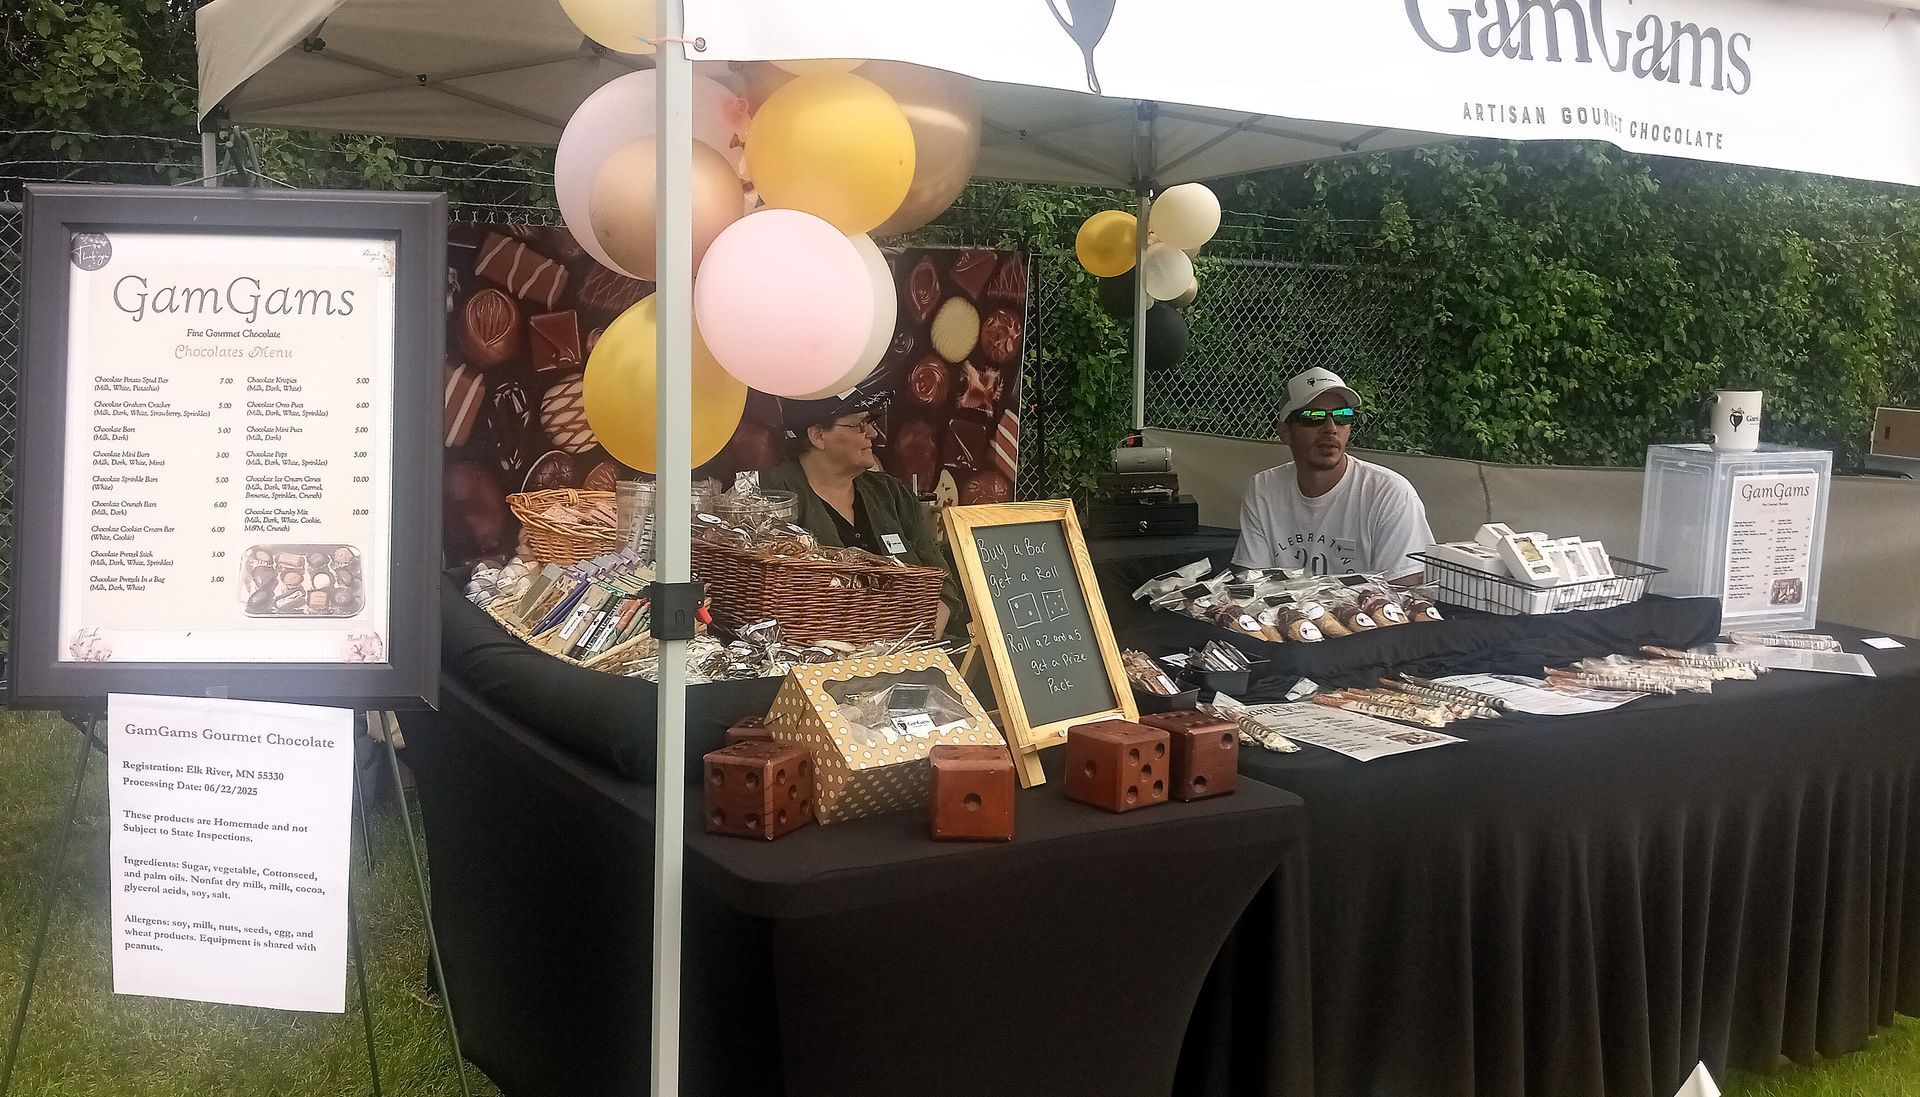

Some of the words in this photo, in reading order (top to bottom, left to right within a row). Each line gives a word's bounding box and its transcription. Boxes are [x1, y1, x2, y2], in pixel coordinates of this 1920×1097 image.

[1462, 101, 1546, 125] ARTISAN
[1629, 120, 1724, 150] CHOCOLATE
[112, 274, 355, 324] GamGams
[186, 328, 204, 338] Fine
[205, 329, 240, 338] Gourmet
[242, 330, 281, 339] Chocolate
[174, 344, 244, 359] Chocolates
[248, 345, 293, 359] Menu
[1741, 482, 1810, 502] GamGams
[977, 538, 1008, 569] Buy
[1014, 546, 1022, 556] a
[1024, 537, 1047, 556] Bar
[989, 571, 1012, 597] get
[1020, 573, 1029, 582] a
[1036, 565, 1058, 580] Roll
[1007, 634, 1031, 653] Roll
[1036, 638, 1042, 647] a
[1042, 635, 1051, 647] 2
[1053, 633, 1066, 643] and
[1074, 629, 1081, 641] 5
[1031, 659, 1047, 675] get
[1052, 659, 1060, 667] a
[1062, 652, 1087, 667] Prize
[1048, 677, 1074, 695] Pack
[124, 724, 198, 739] GamGams
[202, 729, 262, 744] Gourmet
[266, 733, 335, 749] Chocolate
[123, 760, 184, 773] Registration:
[187, 765, 203, 775] Elk
[206, 767, 233, 778] River,
[235, 770, 255, 779] MN
[258, 771, 284, 781] 55330
[123, 777, 174, 791] Processing
[177, 781, 202, 791] Date:
[204, 783, 258, 796] 06/22/2025
[123, 810, 151, 820] These
[154, 813, 194, 824] products
[214, 818, 269, 830] Homemade
[272, 823, 289, 832] and
[292, 824, 308, 833] not
[123, 824, 156, 835] Subject
[171, 828, 194, 837] State
[197, 830, 253, 843] Inspections.
[124, 856, 179, 868] Ingredients:
[181, 861, 211, 873] Sugar,
[213, 864, 260, 877] vegetable,
[262, 868, 318, 881] Cottonseed,
[124, 870, 141, 878] and
[143, 871, 167, 884] palm
[169, 874, 188, 882] oils.
[190, 875, 223, 886] Nonfat
[225, 877, 240, 889] dry
[243, 879, 266, 891] milk,
[269, 882, 293, 893] milk,
[295, 886, 325, 895] cocoa,
[124, 883, 160, 894] glycerol
[162, 887, 189, 897] acids,
[192, 891, 209, 899] soy,
[212, 891, 230, 900] salt.
[124, 915, 169, 926] Allergens:
[172, 920, 190, 929] soy,
[193, 921, 216, 931] milk,
[219, 923, 241, 933] nuts,
[244, 925, 272, 936] seeds,
[274, 930, 294, 939] egg,
[296, 930, 313, 938] and
[124, 928, 151, 937] wheat
[154, 931, 196, 942] products.
[199, 934, 251, 946] Equipment
[253, 938, 261, 947] is
[264, 939, 293, 950] shared
[296, 943, 316, 952] with
[124, 942, 163, 952] peanuts.
